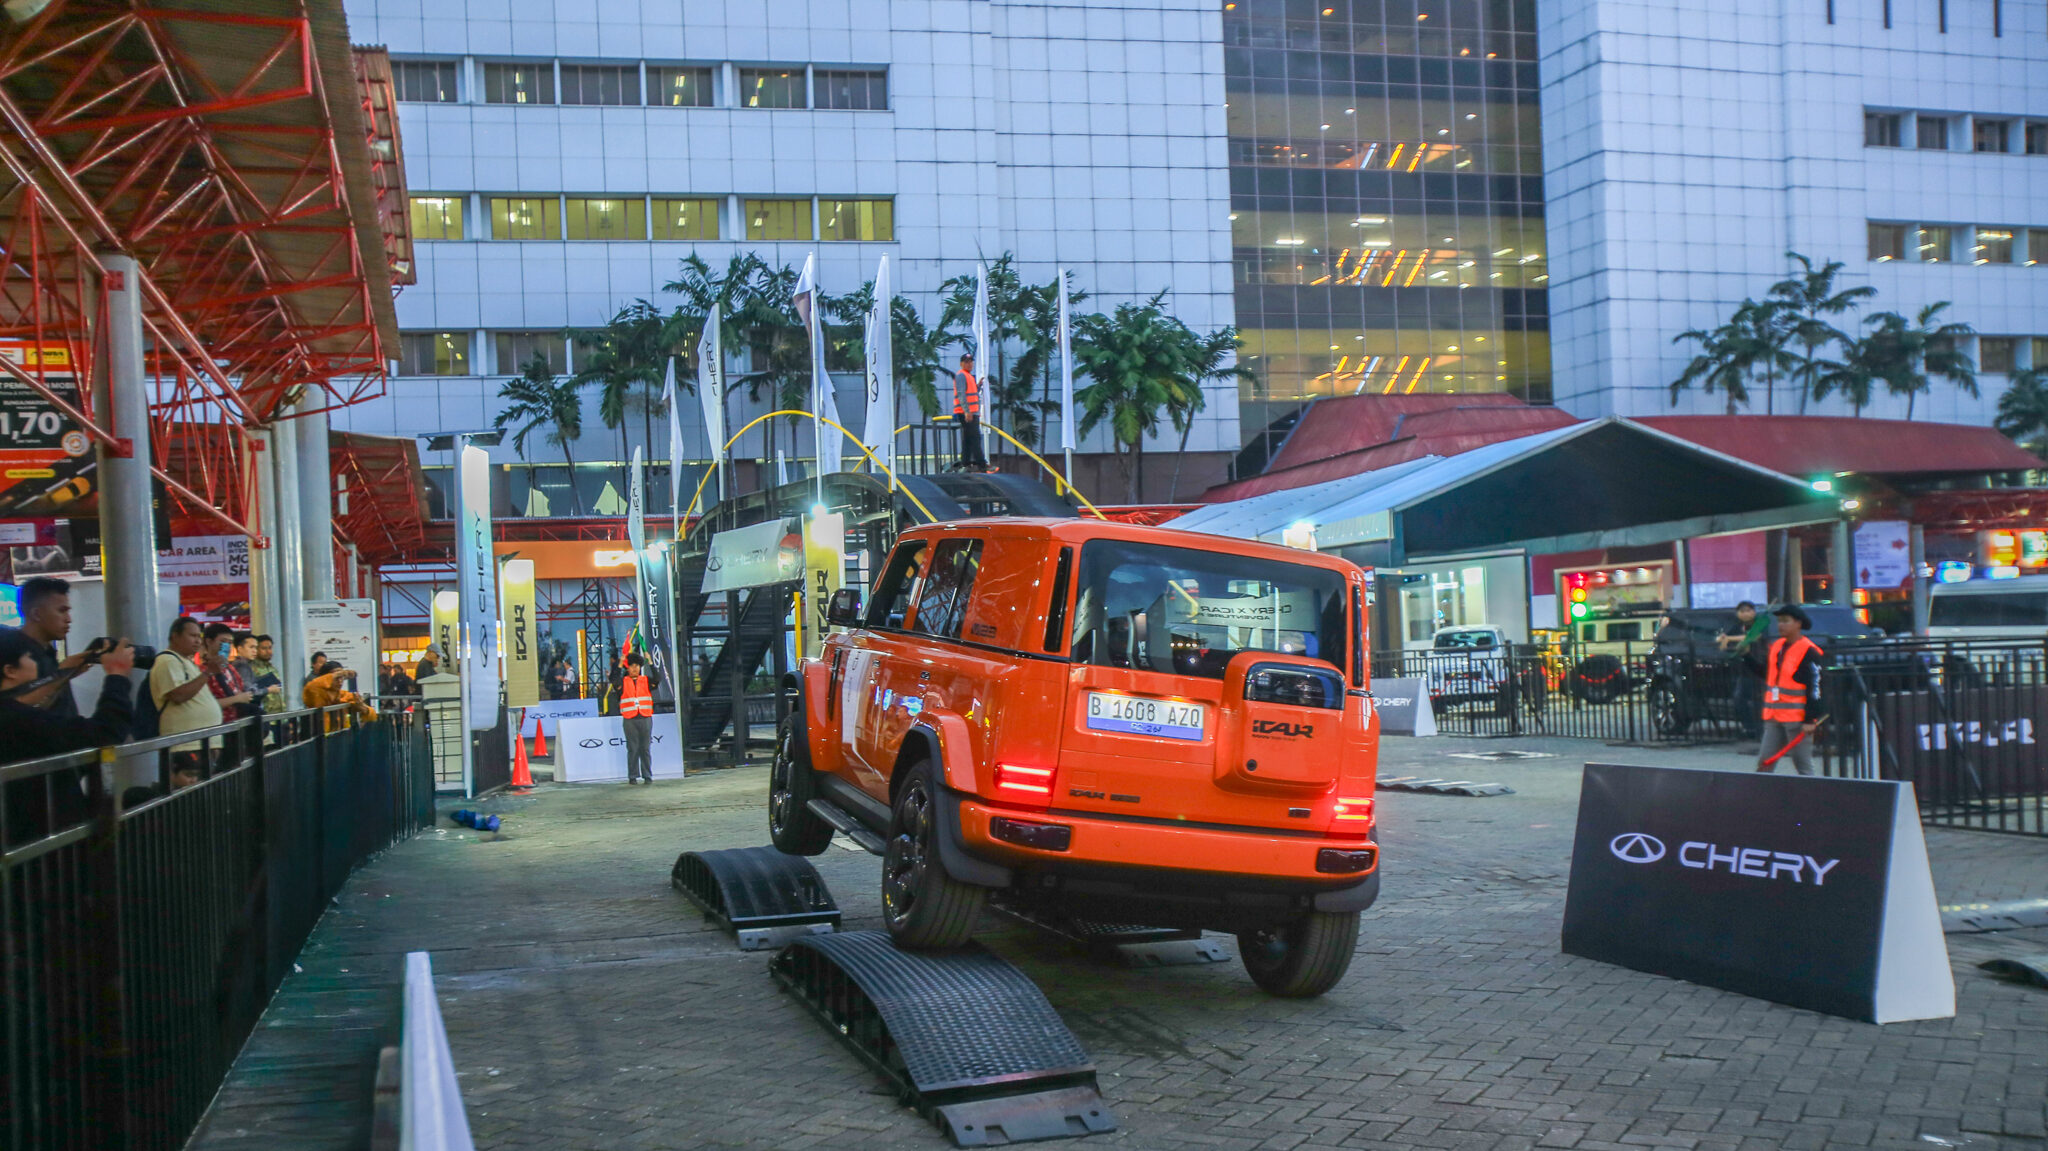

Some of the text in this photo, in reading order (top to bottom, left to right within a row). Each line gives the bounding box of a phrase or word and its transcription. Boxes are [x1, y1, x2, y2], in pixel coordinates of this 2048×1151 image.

[186, 547, 217, 556] AREA
[474, 510, 486, 613] CHERY
[648, 582, 658, 639] CHERY
[1383, 697, 1412, 706] CHERY
[549, 710, 588, 718] CHERY
[1091, 697, 1200, 727] B 1608 AZQ
[609, 735, 664, 746] CHY
[1679, 841, 1840, 886] CHERY
